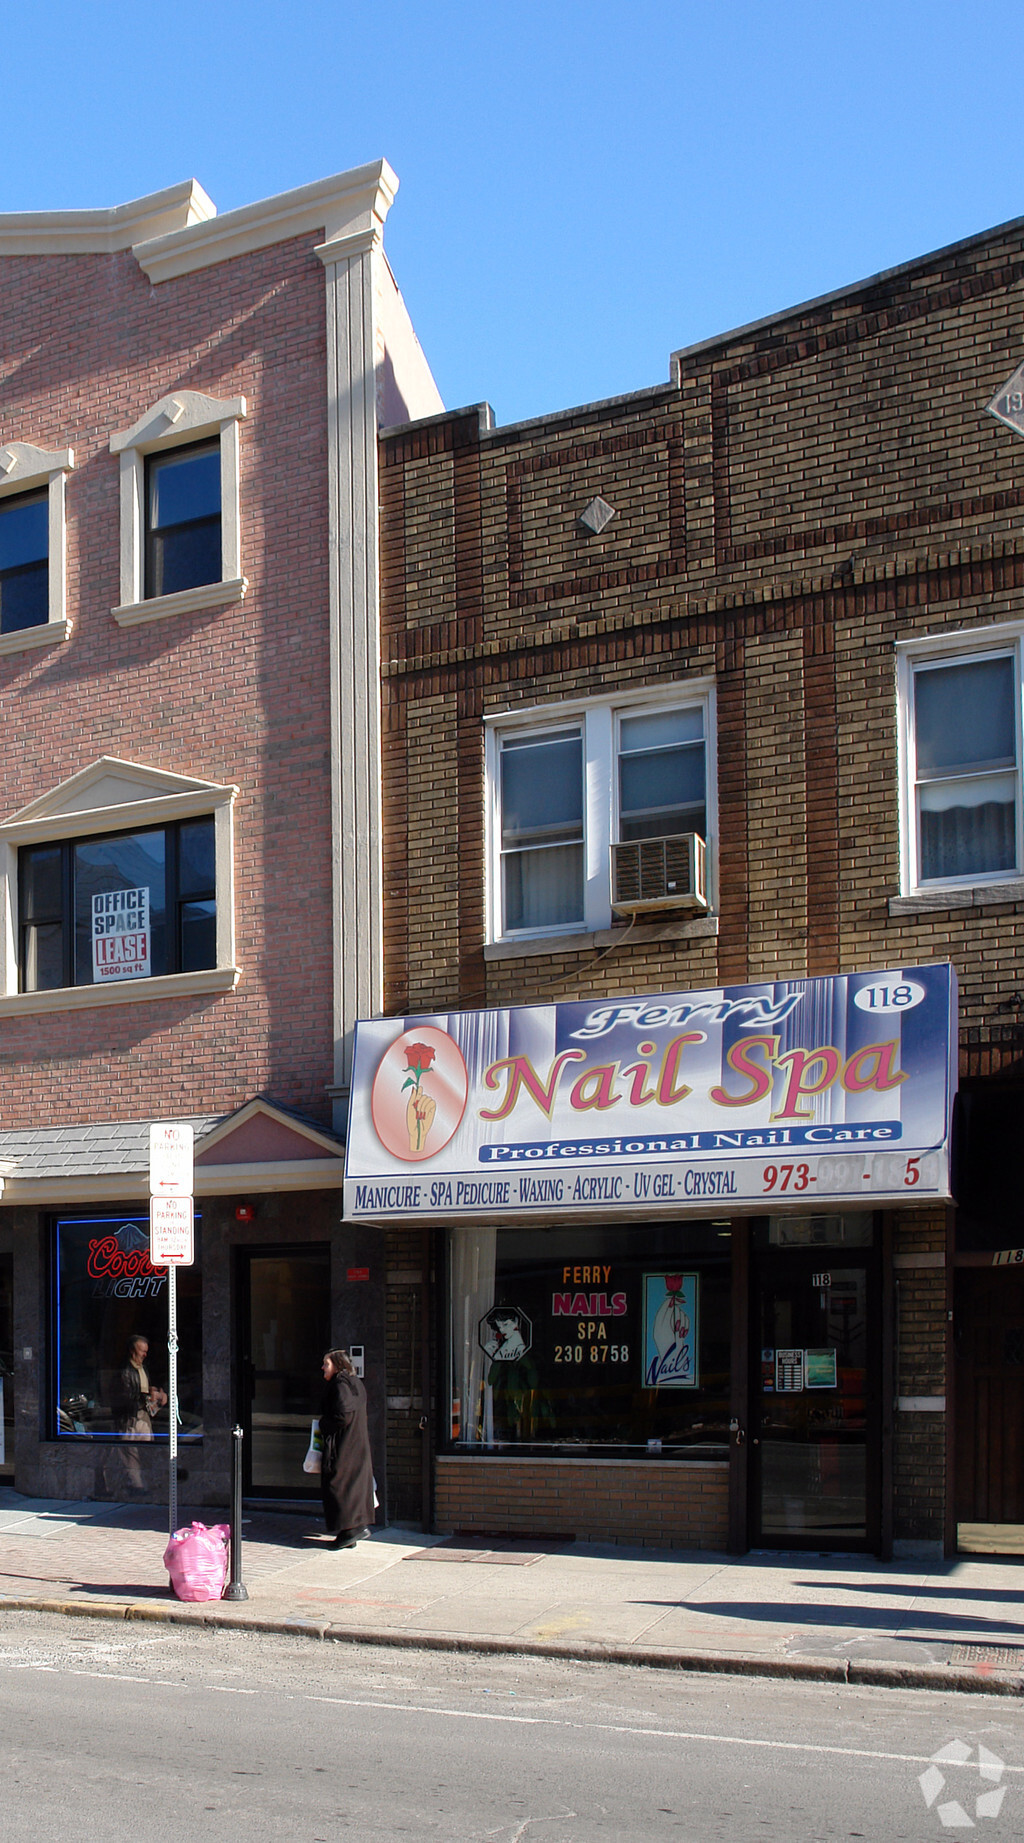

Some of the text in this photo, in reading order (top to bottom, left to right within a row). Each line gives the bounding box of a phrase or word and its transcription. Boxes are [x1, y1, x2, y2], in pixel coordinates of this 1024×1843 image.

[94, 889, 145, 914] OFFICE
[94, 911, 145, 935] SPACE
[97, 934, 145, 965] LEASE
[100, 966, 121, 976] 1500
[122, 966, 133, 974] sq
[867, 985, 912, 1008] 118
[573, 991, 804, 1038] Ferry
[477, 1031, 910, 1122] Nail Spa
[164, 1129, 180, 1140] NO
[488, 1127, 893, 1161] Professional Nail Care
[154, 1143, 190, 1151] PARKING
[354, 1185, 421, 1209] MANICURE
[430, 1181, 452, 1206] SPA
[456, 1181, 510, 1204] PEDICURE
[519, 1178, 564, 1203] WAXING
[573, 1175, 623, 1200] ACRYLIC
[653, 1174, 675, 1197] GEL
[684, 1169, 737, 1196] CRYSTAL
[156, 1211, 187, 1220] PARKING
[166, 1202, 177, 1210] NO
[154, 1225, 190, 1235] STANDING
[563, 1266, 611, 1284] FERRY
[813, 1274, 831, 1286] 118
[92, 1276, 167, 1298] LIGHT
[552, 1293, 627, 1316] NAILS
[578, 1322, 607, 1340] SPA
[554, 1345, 629, 1363] 230 8758
[646, 1342, 692, 1385] Nails
